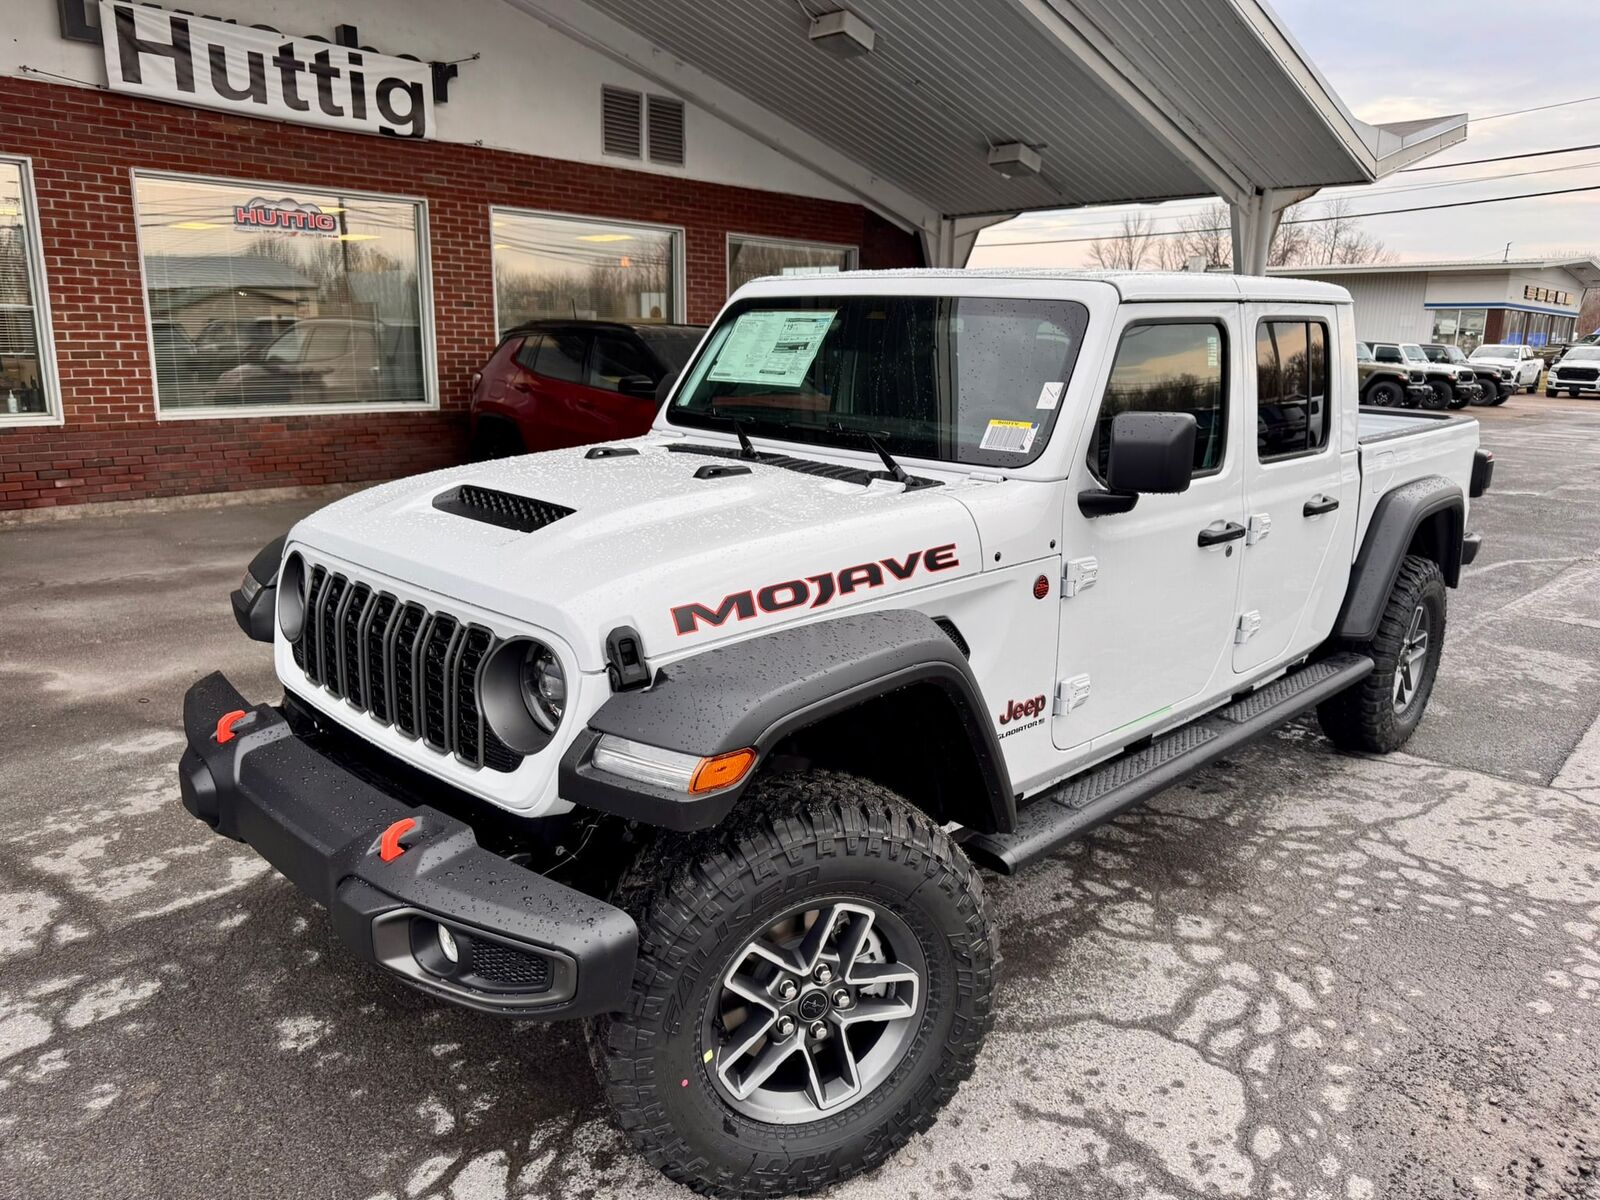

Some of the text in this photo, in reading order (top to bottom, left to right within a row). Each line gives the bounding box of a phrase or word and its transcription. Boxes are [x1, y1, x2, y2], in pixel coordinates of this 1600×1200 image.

[113, 4, 426, 138] Huttig
[235, 206, 336, 231] HUTTIG
[670, 543, 960, 636] MOJAVE
[997, 720, 1038, 739] GLADIATOR
[999, 694, 1046, 725] Jeep
[662, 864, 821, 1036] FALKEN
